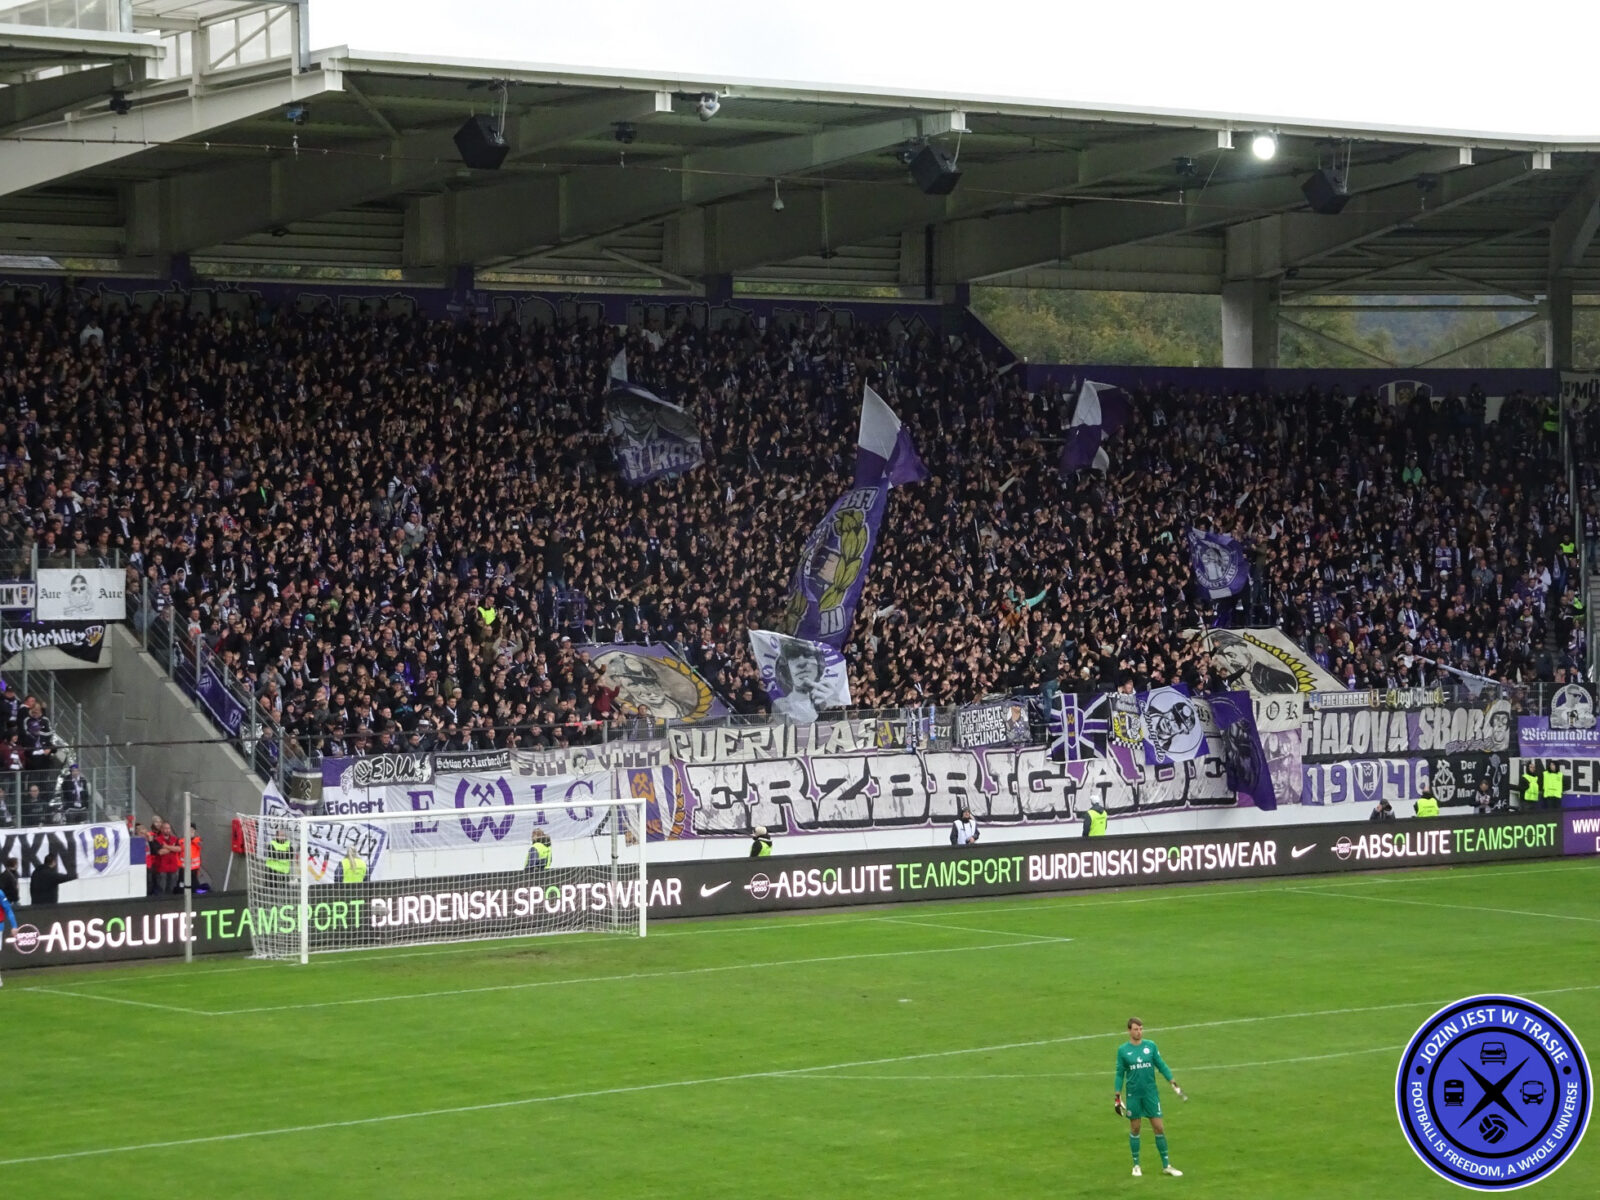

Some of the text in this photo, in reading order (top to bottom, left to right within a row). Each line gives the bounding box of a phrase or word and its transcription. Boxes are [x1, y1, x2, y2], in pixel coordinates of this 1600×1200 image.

[40, 588, 61, 600] Aue
[98, 588, 122, 600] Aue
[959, 706, 1003, 725] FREIHEIT
[669, 718, 877, 763] GUERILLAS
[960, 728, 1006, 748] FREUNDE
[1521, 726, 1600, 741] Wismutadler
[1460, 760, 1477, 771] Der
[326, 798, 384, 815] Eichert
[1355, 823, 1557, 860] ABSOLUTE TEAMSPORT
[1029, 840, 1277, 882] BURDENSKI SPORTSWEAR
[775, 856, 1024, 899] ABSOLUTE TEAMSPORT
[371, 877, 682, 927] BURDENSKI SPORTSWEAR
[17, 931, 38, 940] SPORT
[46, 899, 365, 953] ABSOLUTE TEAMSPORT
[17, 938, 37, 947] 2000
